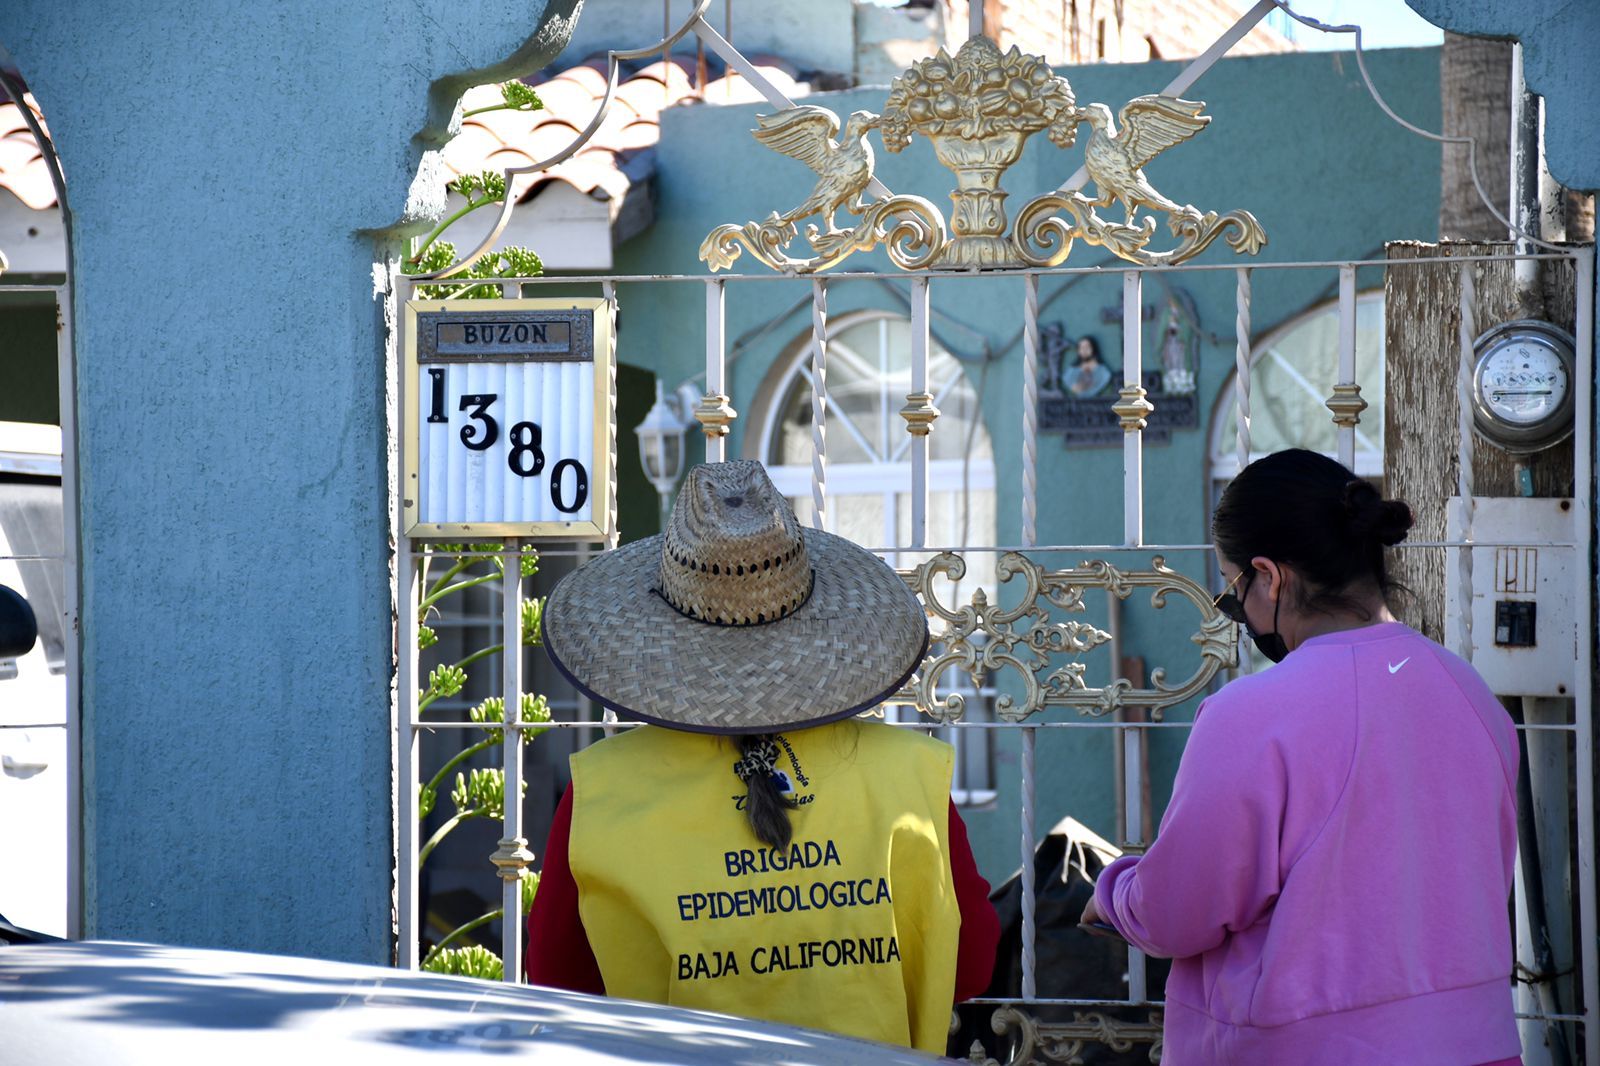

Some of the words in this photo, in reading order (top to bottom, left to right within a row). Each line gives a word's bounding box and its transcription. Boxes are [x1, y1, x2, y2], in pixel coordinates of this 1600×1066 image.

[464, 324, 547, 344] BUZON
[427, 368, 588, 513] 1380
[774, 734, 809, 787] pidemiología
[725, 840, 841, 877] BRIGADA
[677, 878, 891, 920] EPIDEMIOLOGICA
[678, 952, 739, 980] BAJA
[751, 937, 901, 973] CALIFORNIA
